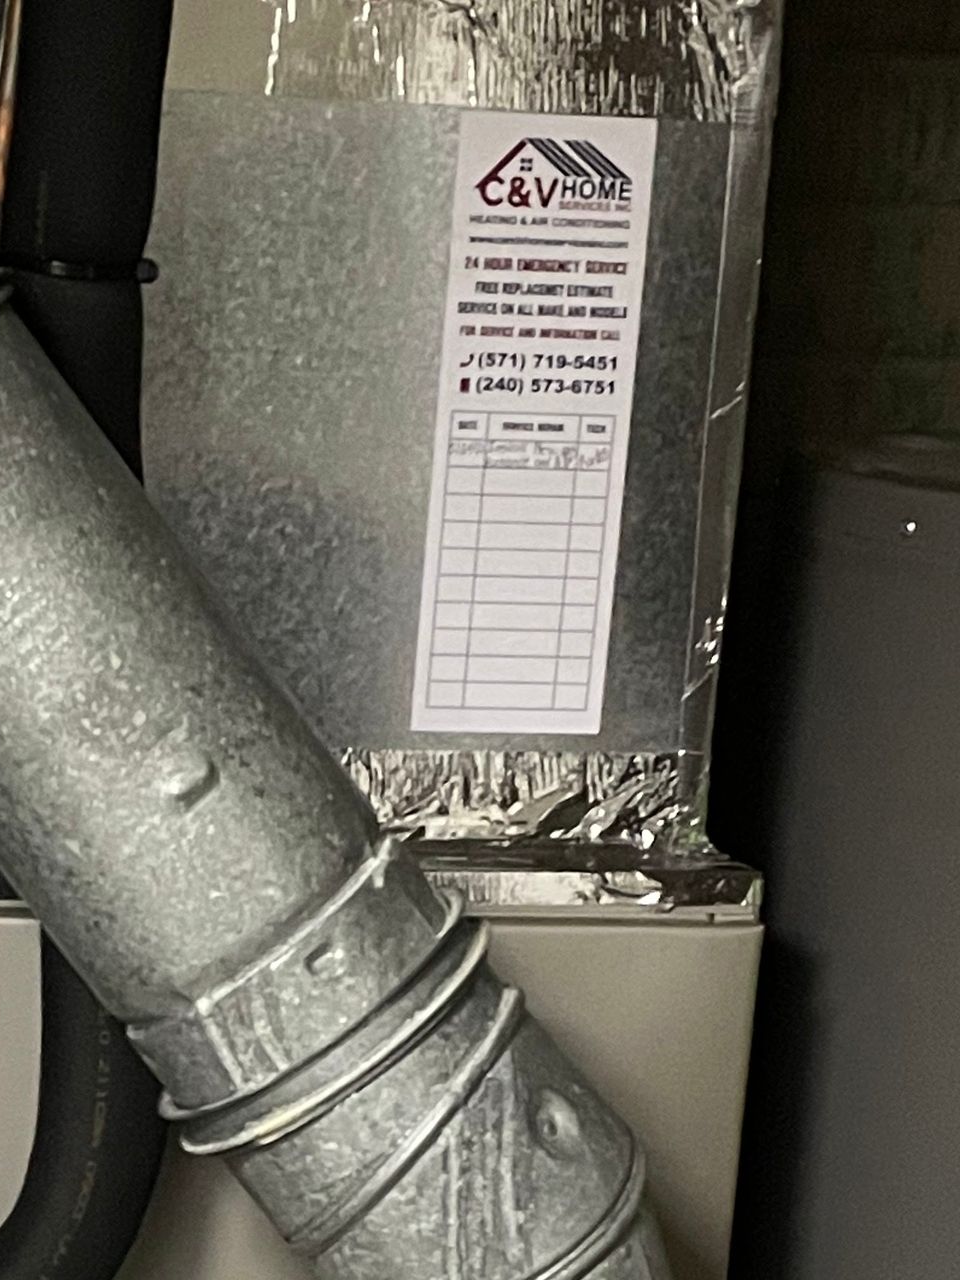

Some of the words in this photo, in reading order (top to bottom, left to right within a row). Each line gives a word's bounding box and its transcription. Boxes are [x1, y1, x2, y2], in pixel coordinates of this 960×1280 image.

[477, 175, 558, 208] C&V
[560, 178, 632, 201] HOME
[559, 200, 611, 212] SERVICES
[469, 215, 517, 225] HEATING
[520, 216, 527, 225] &
[531, 217, 548, 225] AIR
[551, 217, 631, 229] CONDITIONING
[465, 256, 478, 269] 24
[484, 257, 513, 270] HOUR
[517, 258, 579, 272] EMERGENCY
[586, 260, 627, 274] SERVICE
[475, 281, 498, 294] FREE
[567, 285, 613, 297] ESTIMATE
[457, 302, 497, 314] SERVICE
[501, 303, 514, 315] ON
[517, 304, 533, 315] ALL
[568, 305, 586, 317] AND
[460, 325, 476, 336] FOR
[480, 326, 514, 337] SERVICE
[518, 327, 536, 337] AND
[540, 328, 597, 339] INFORMATION
[601, 330, 620, 340] CALL
[478, 352, 526, 371] (571)
[533, 353, 617, 370] 719-5451
[476, 376, 524, 395] (240)
[531, 378, 615, 394] 573-6751
